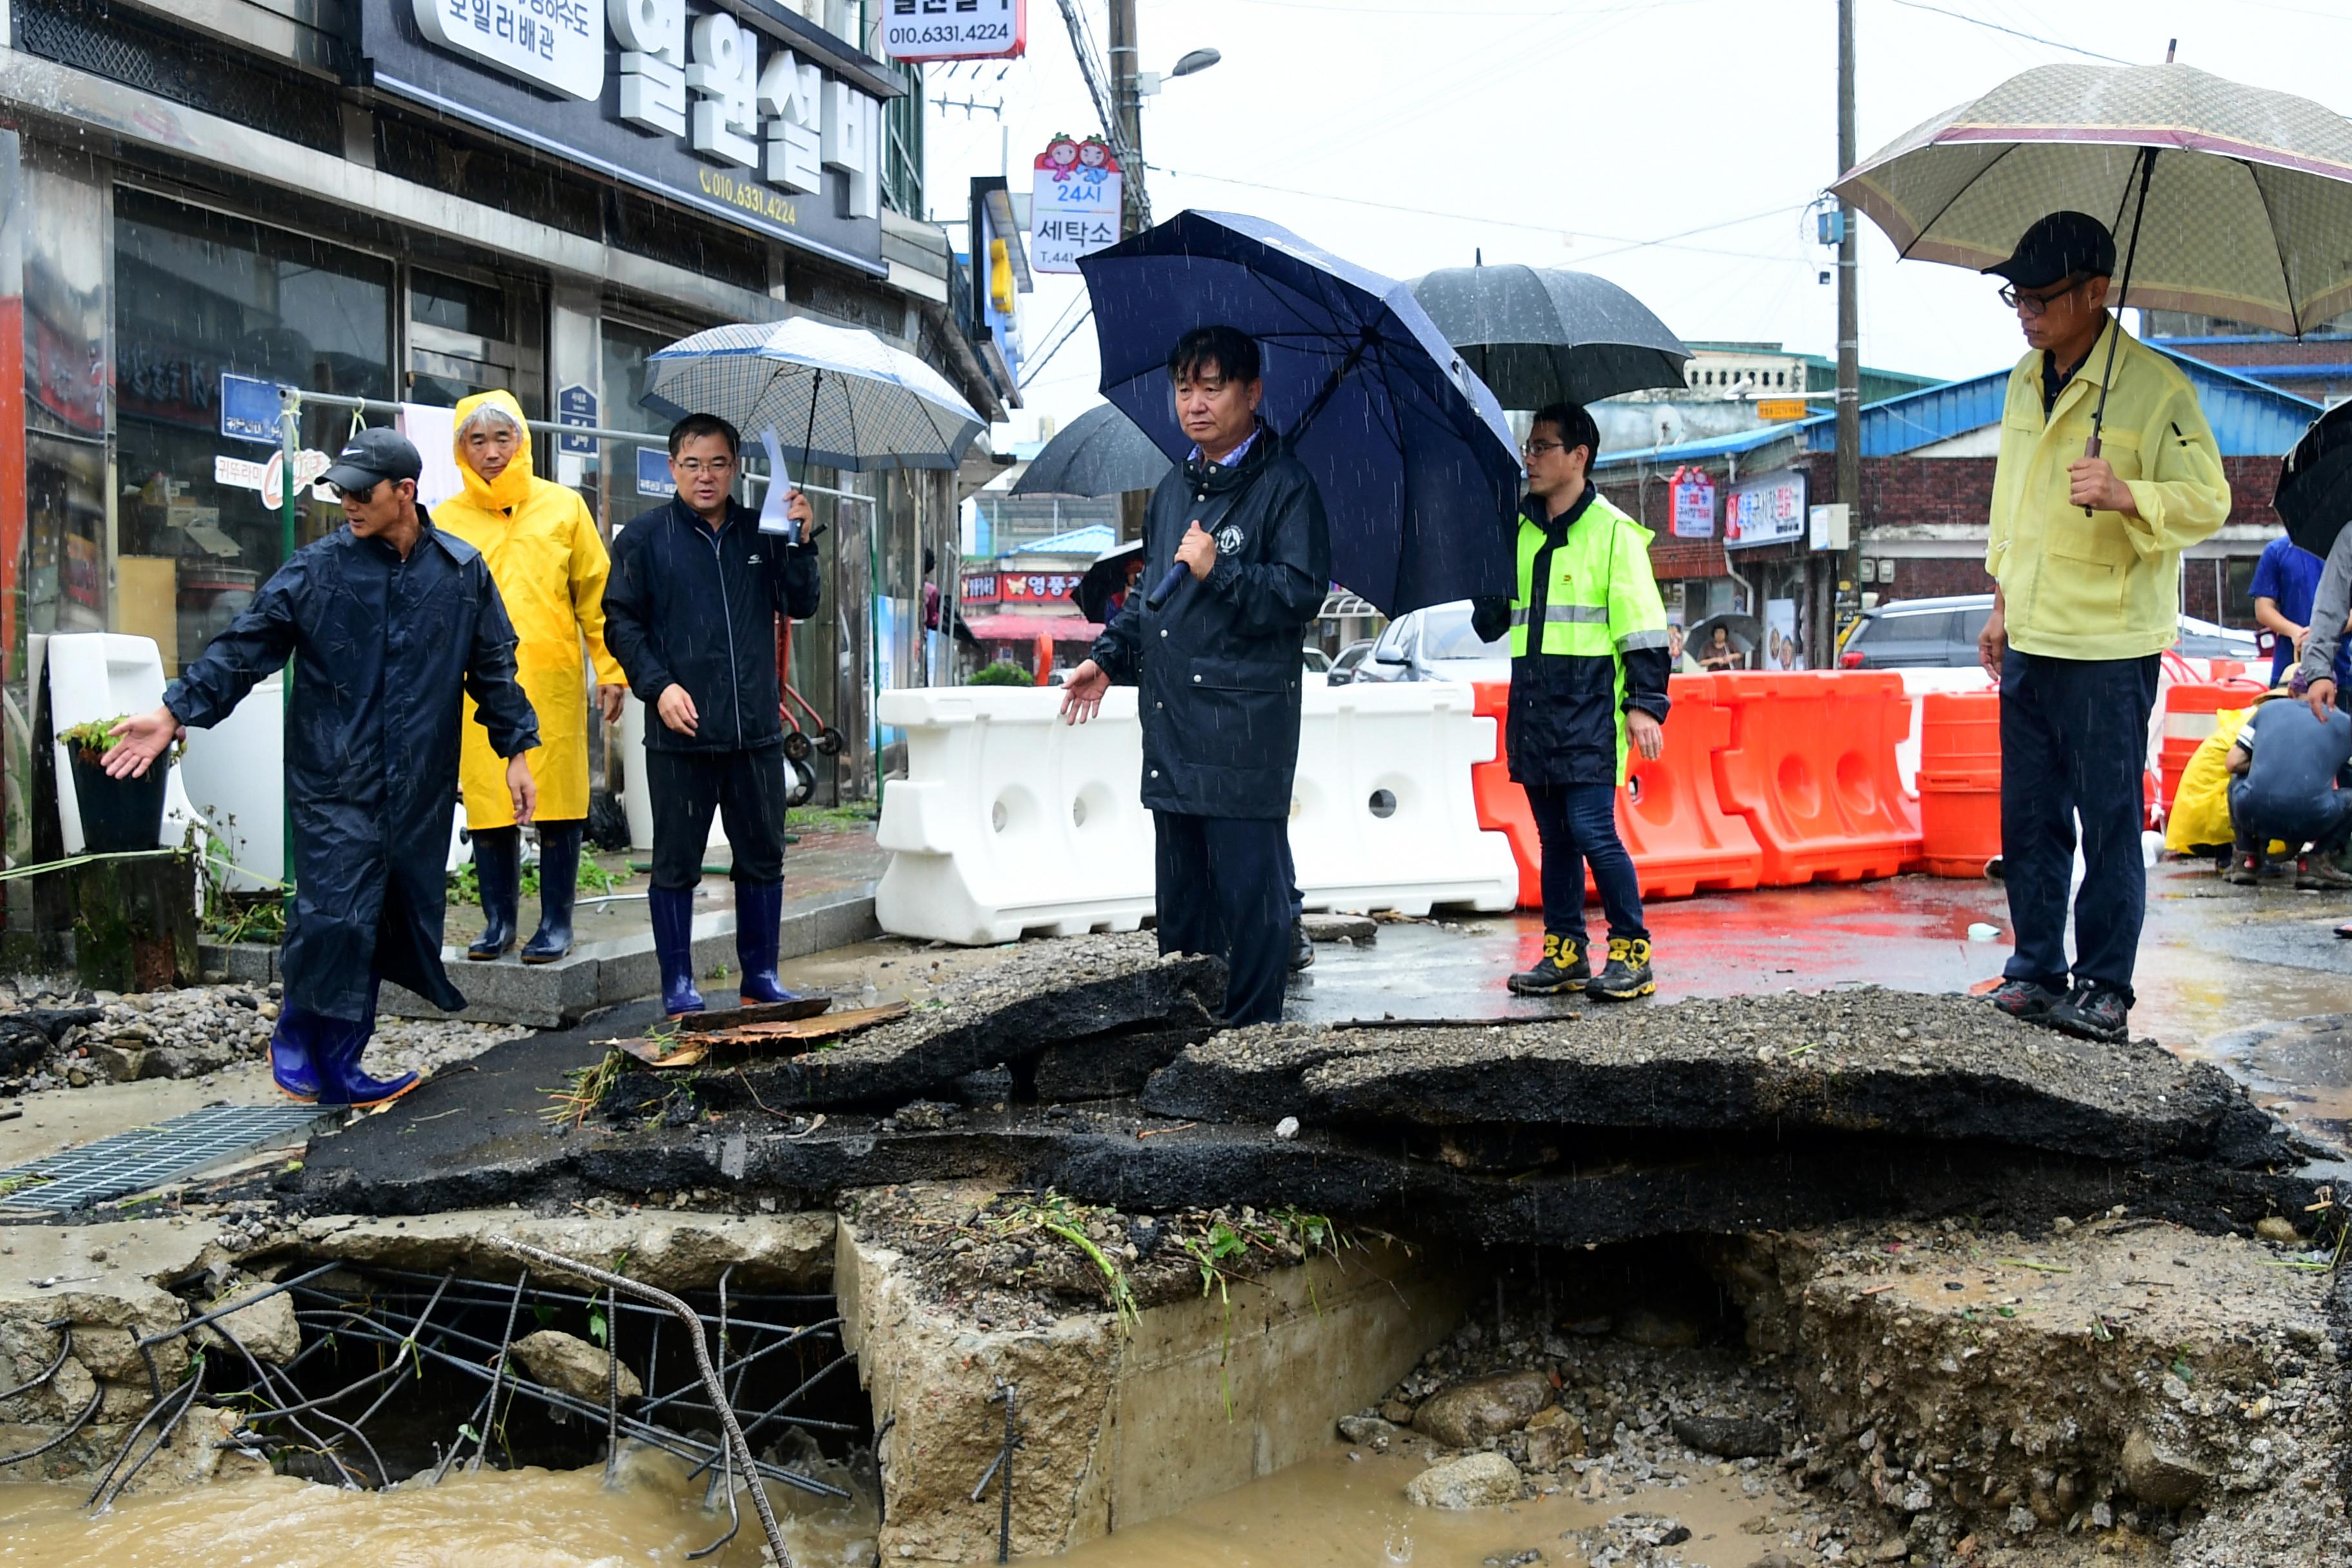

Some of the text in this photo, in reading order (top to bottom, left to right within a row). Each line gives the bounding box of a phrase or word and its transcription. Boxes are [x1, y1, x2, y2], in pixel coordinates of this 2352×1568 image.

[890, 23, 1008, 44] 010.6331.4224
[712, 173, 796, 226] 010.6331.4224
[1058, 184, 1101, 203] 24시
[1037, 220, 1113, 248] 세탁소
[218, 458, 263, 488] 귀뚜라미
